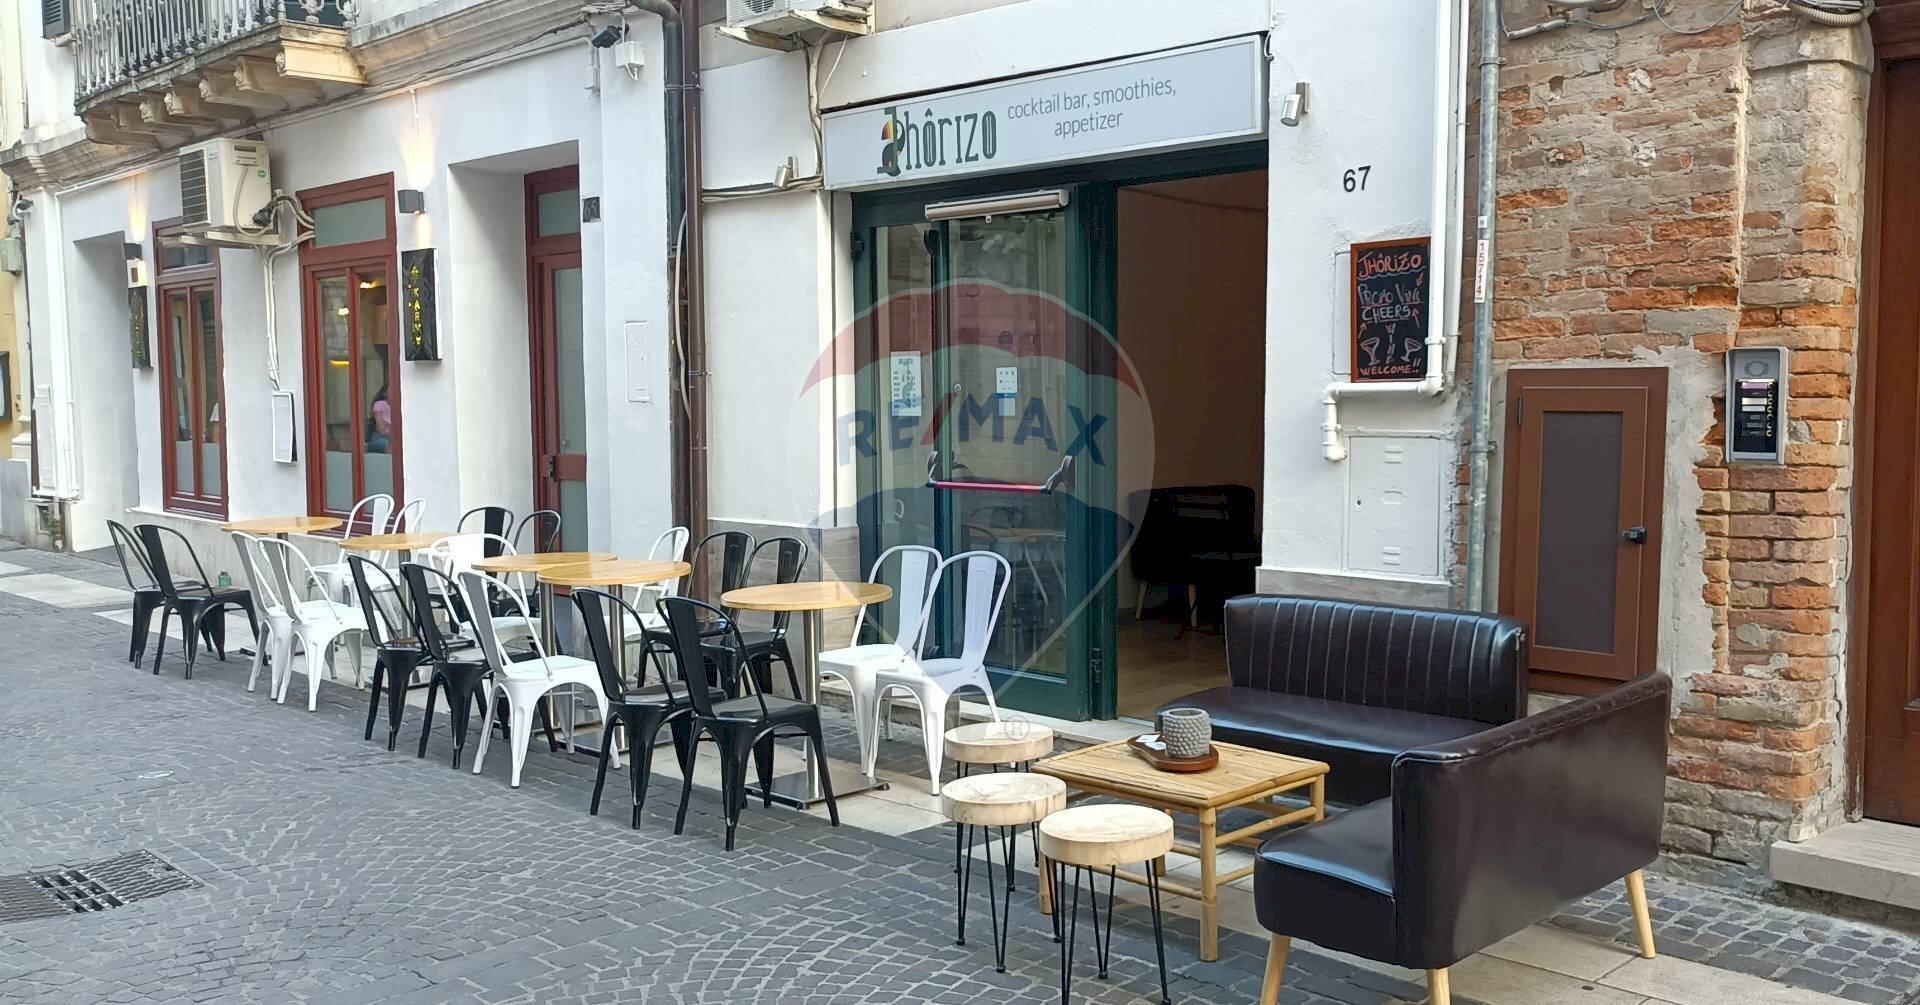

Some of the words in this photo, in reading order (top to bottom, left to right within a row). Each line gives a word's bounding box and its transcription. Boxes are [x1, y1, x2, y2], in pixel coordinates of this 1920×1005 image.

[1007, 93, 1060, 120] cocktail
[1064, 91, 1090, 112] bar,
[1093, 78, 1176, 107] smoothies,
[1054, 111, 1124, 139] appetizer
[1343, 165, 1371, 192] 67
[1362, 304, 1411, 323] CHEERS
